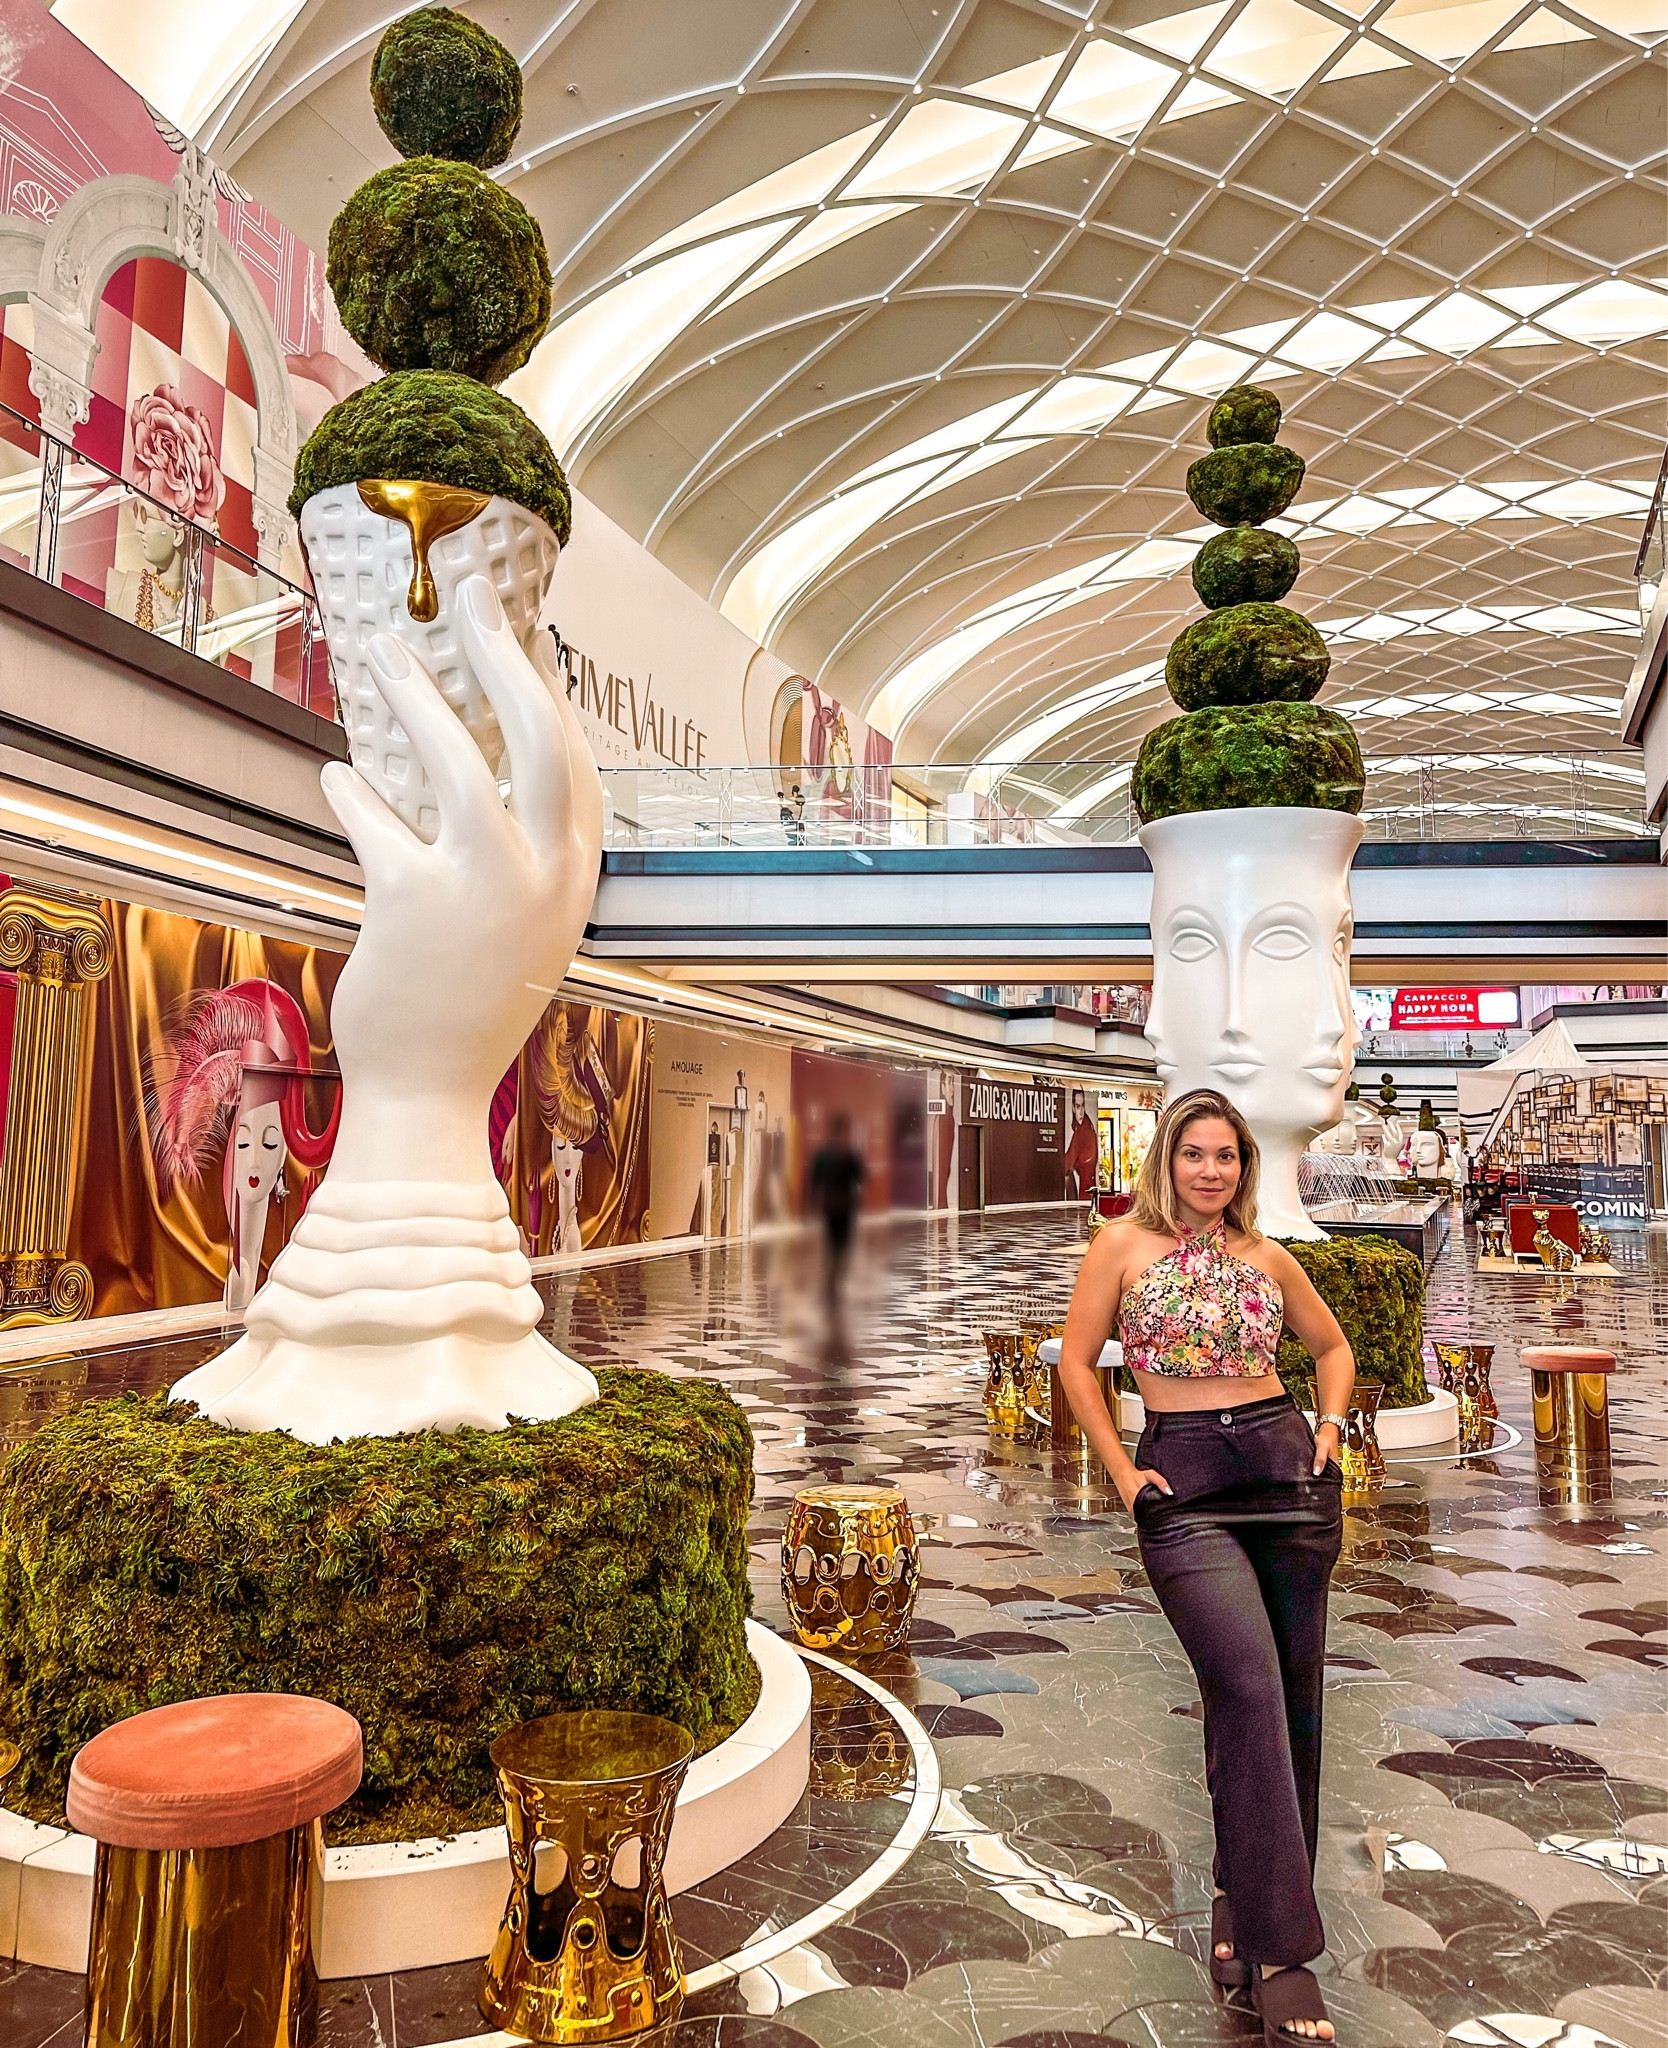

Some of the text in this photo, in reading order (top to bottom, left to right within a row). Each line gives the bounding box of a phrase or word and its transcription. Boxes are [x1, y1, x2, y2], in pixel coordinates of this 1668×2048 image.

[1404, 994, 1467, 1002] CARPACCIO
[1398, 1003, 1474, 1014] HAPPY HOUR
[670, 1060, 703, 1075] AMOUAGE
[1572, 1200, 1645, 1217] COMIN
